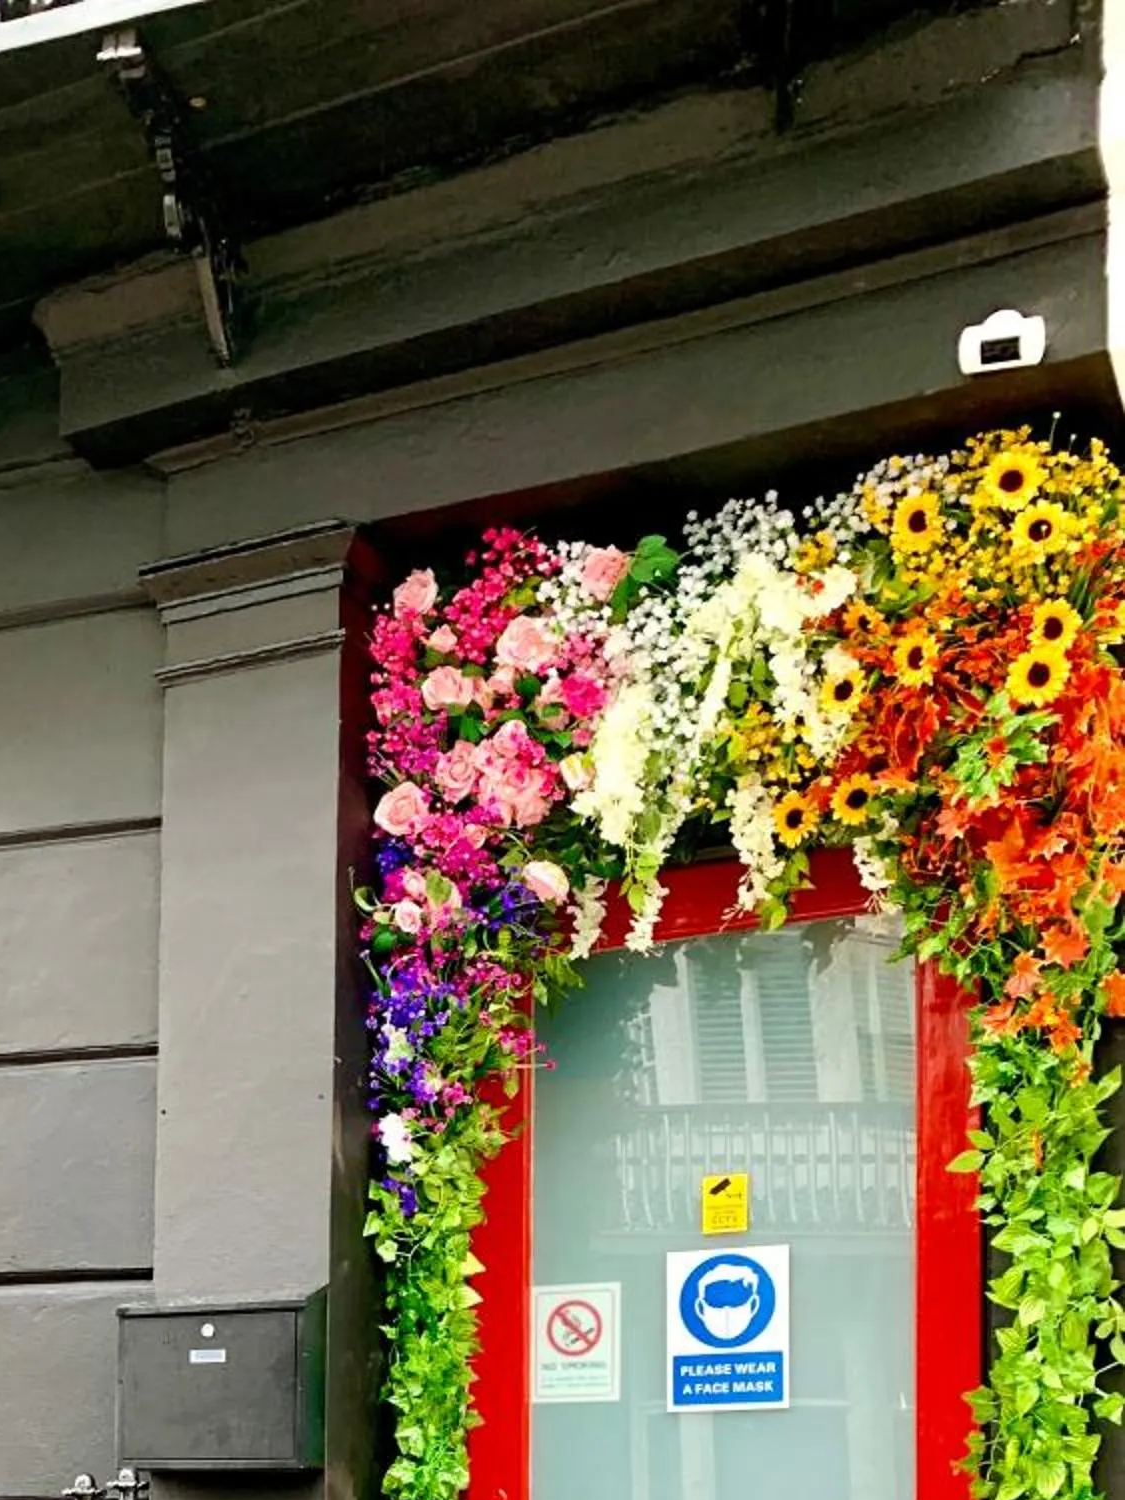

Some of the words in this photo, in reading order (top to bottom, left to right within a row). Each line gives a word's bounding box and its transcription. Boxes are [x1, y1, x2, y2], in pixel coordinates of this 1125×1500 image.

[680, 1363, 732, 1377] PLEASE
[734, 1361, 776, 1375] WEAR
[682, 1383, 693, 1395] A
[695, 1382, 730, 1395] FACE
[732, 1380, 774, 1393] MASK
